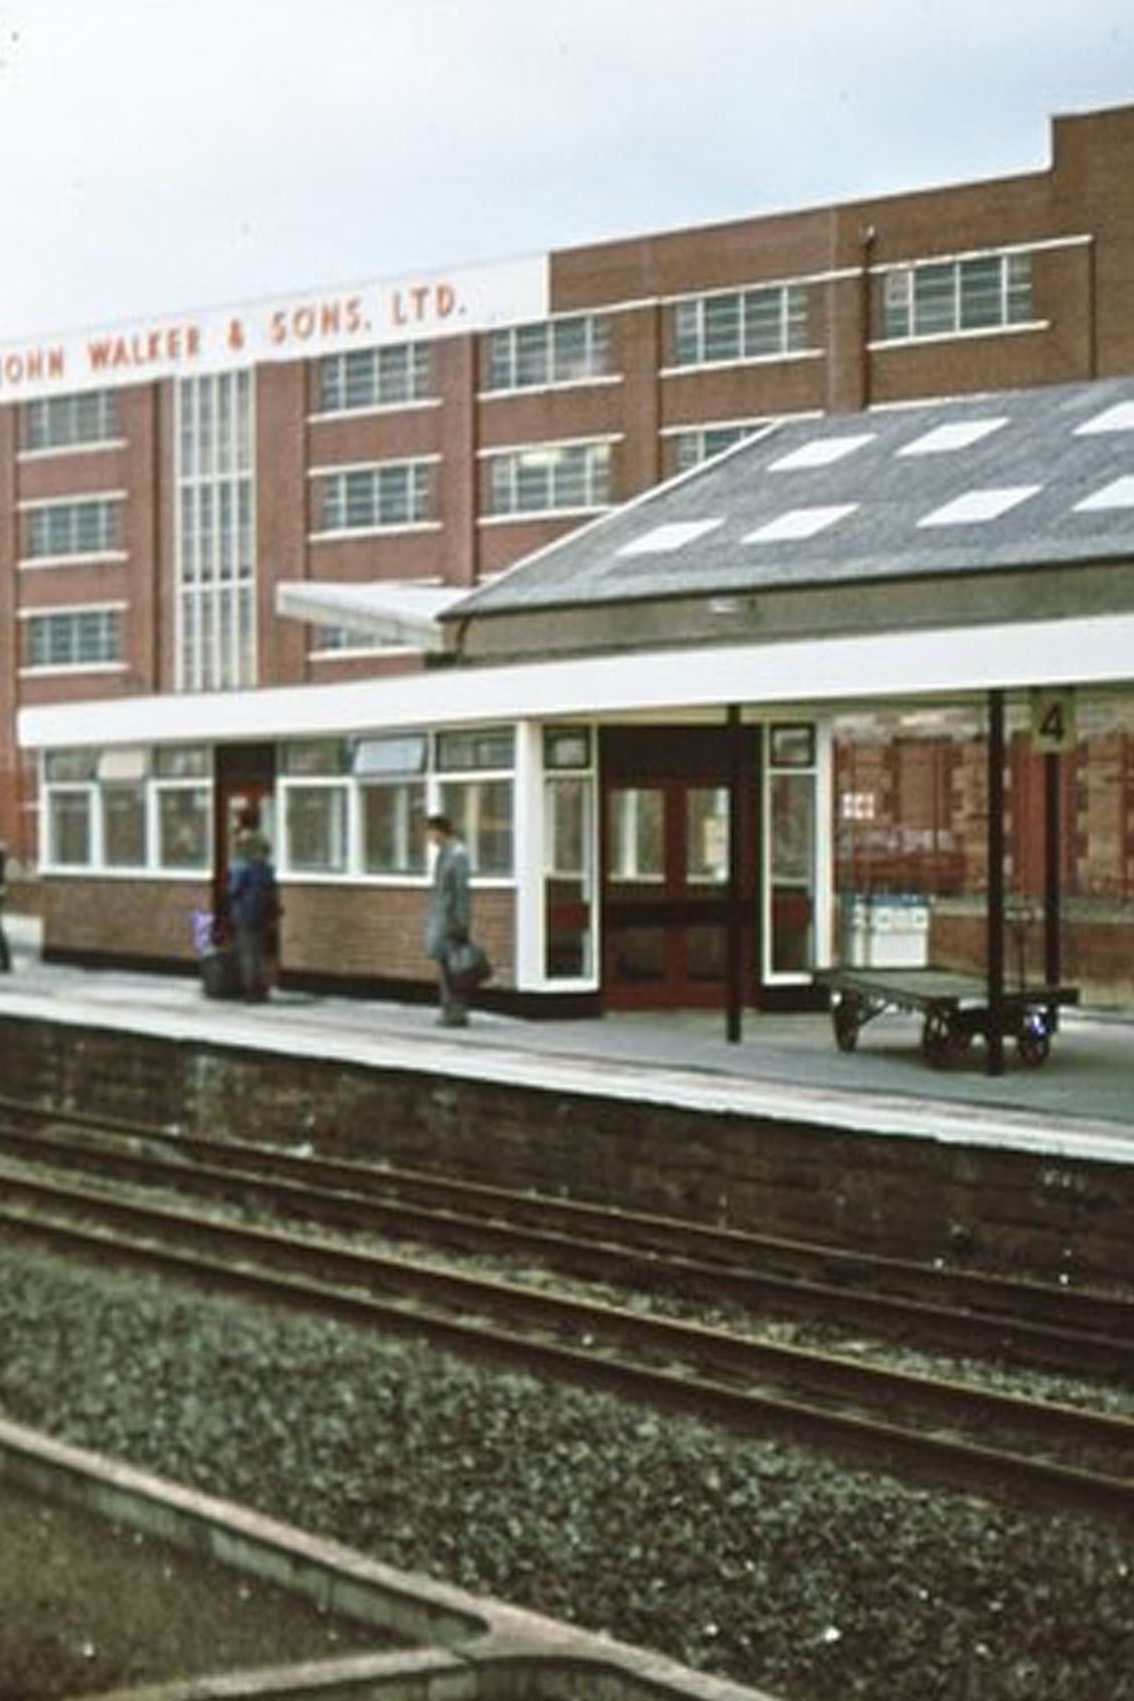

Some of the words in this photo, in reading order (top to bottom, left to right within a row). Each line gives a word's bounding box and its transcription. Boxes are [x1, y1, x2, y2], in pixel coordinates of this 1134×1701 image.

[87, 326, 200, 371] WALKER
[227, 318, 244, 350] &
[392, 284, 468, 326] LTD.
[1039, 702, 1065, 742] 4
